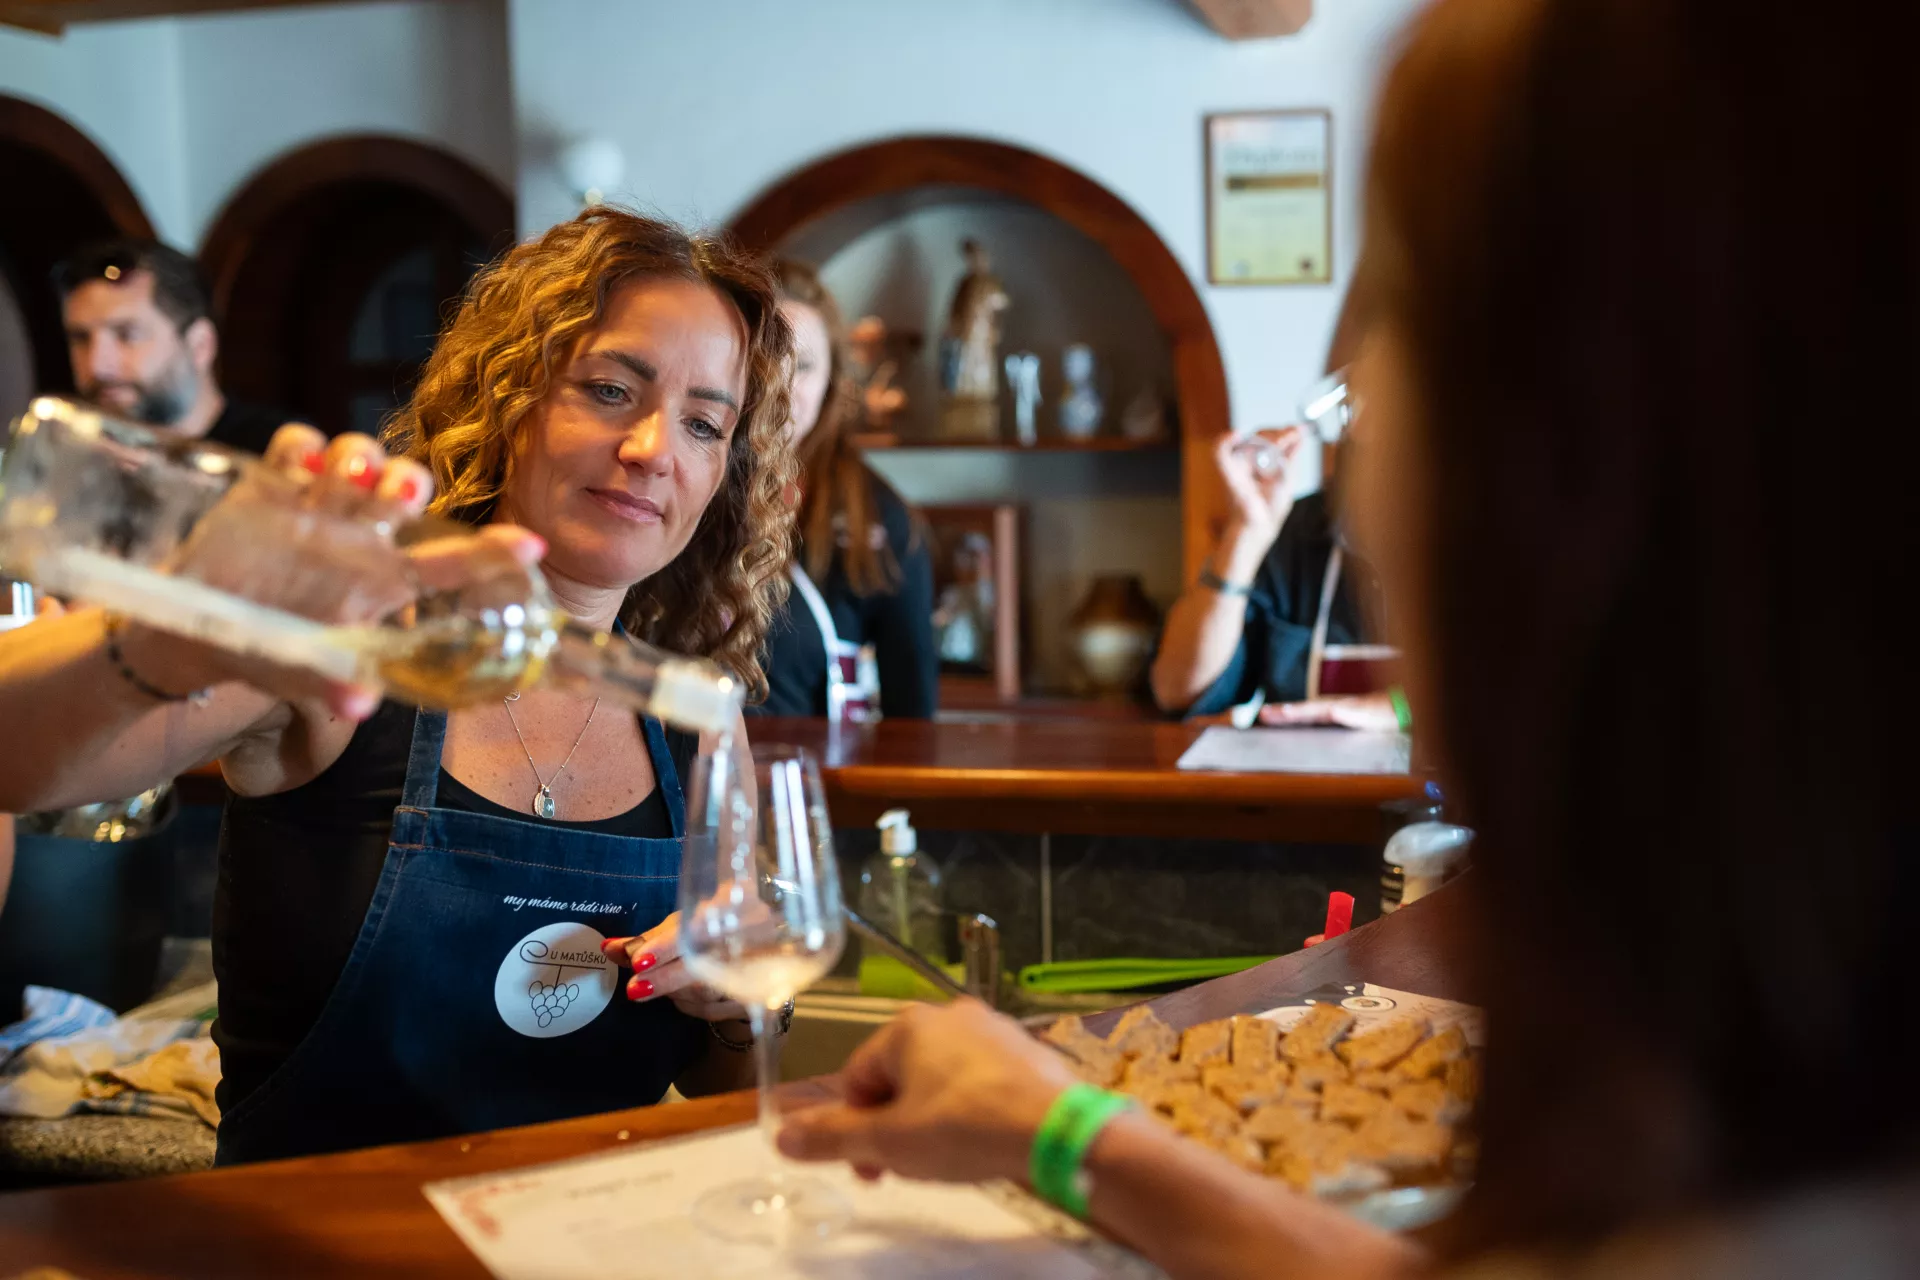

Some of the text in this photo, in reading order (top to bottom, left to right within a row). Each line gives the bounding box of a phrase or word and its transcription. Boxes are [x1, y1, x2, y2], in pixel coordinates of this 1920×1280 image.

[503, 895, 527, 912] my
[527, 896, 568, 910] máme
[570, 900, 599, 913] rádi
[550, 951, 558, 960] U
